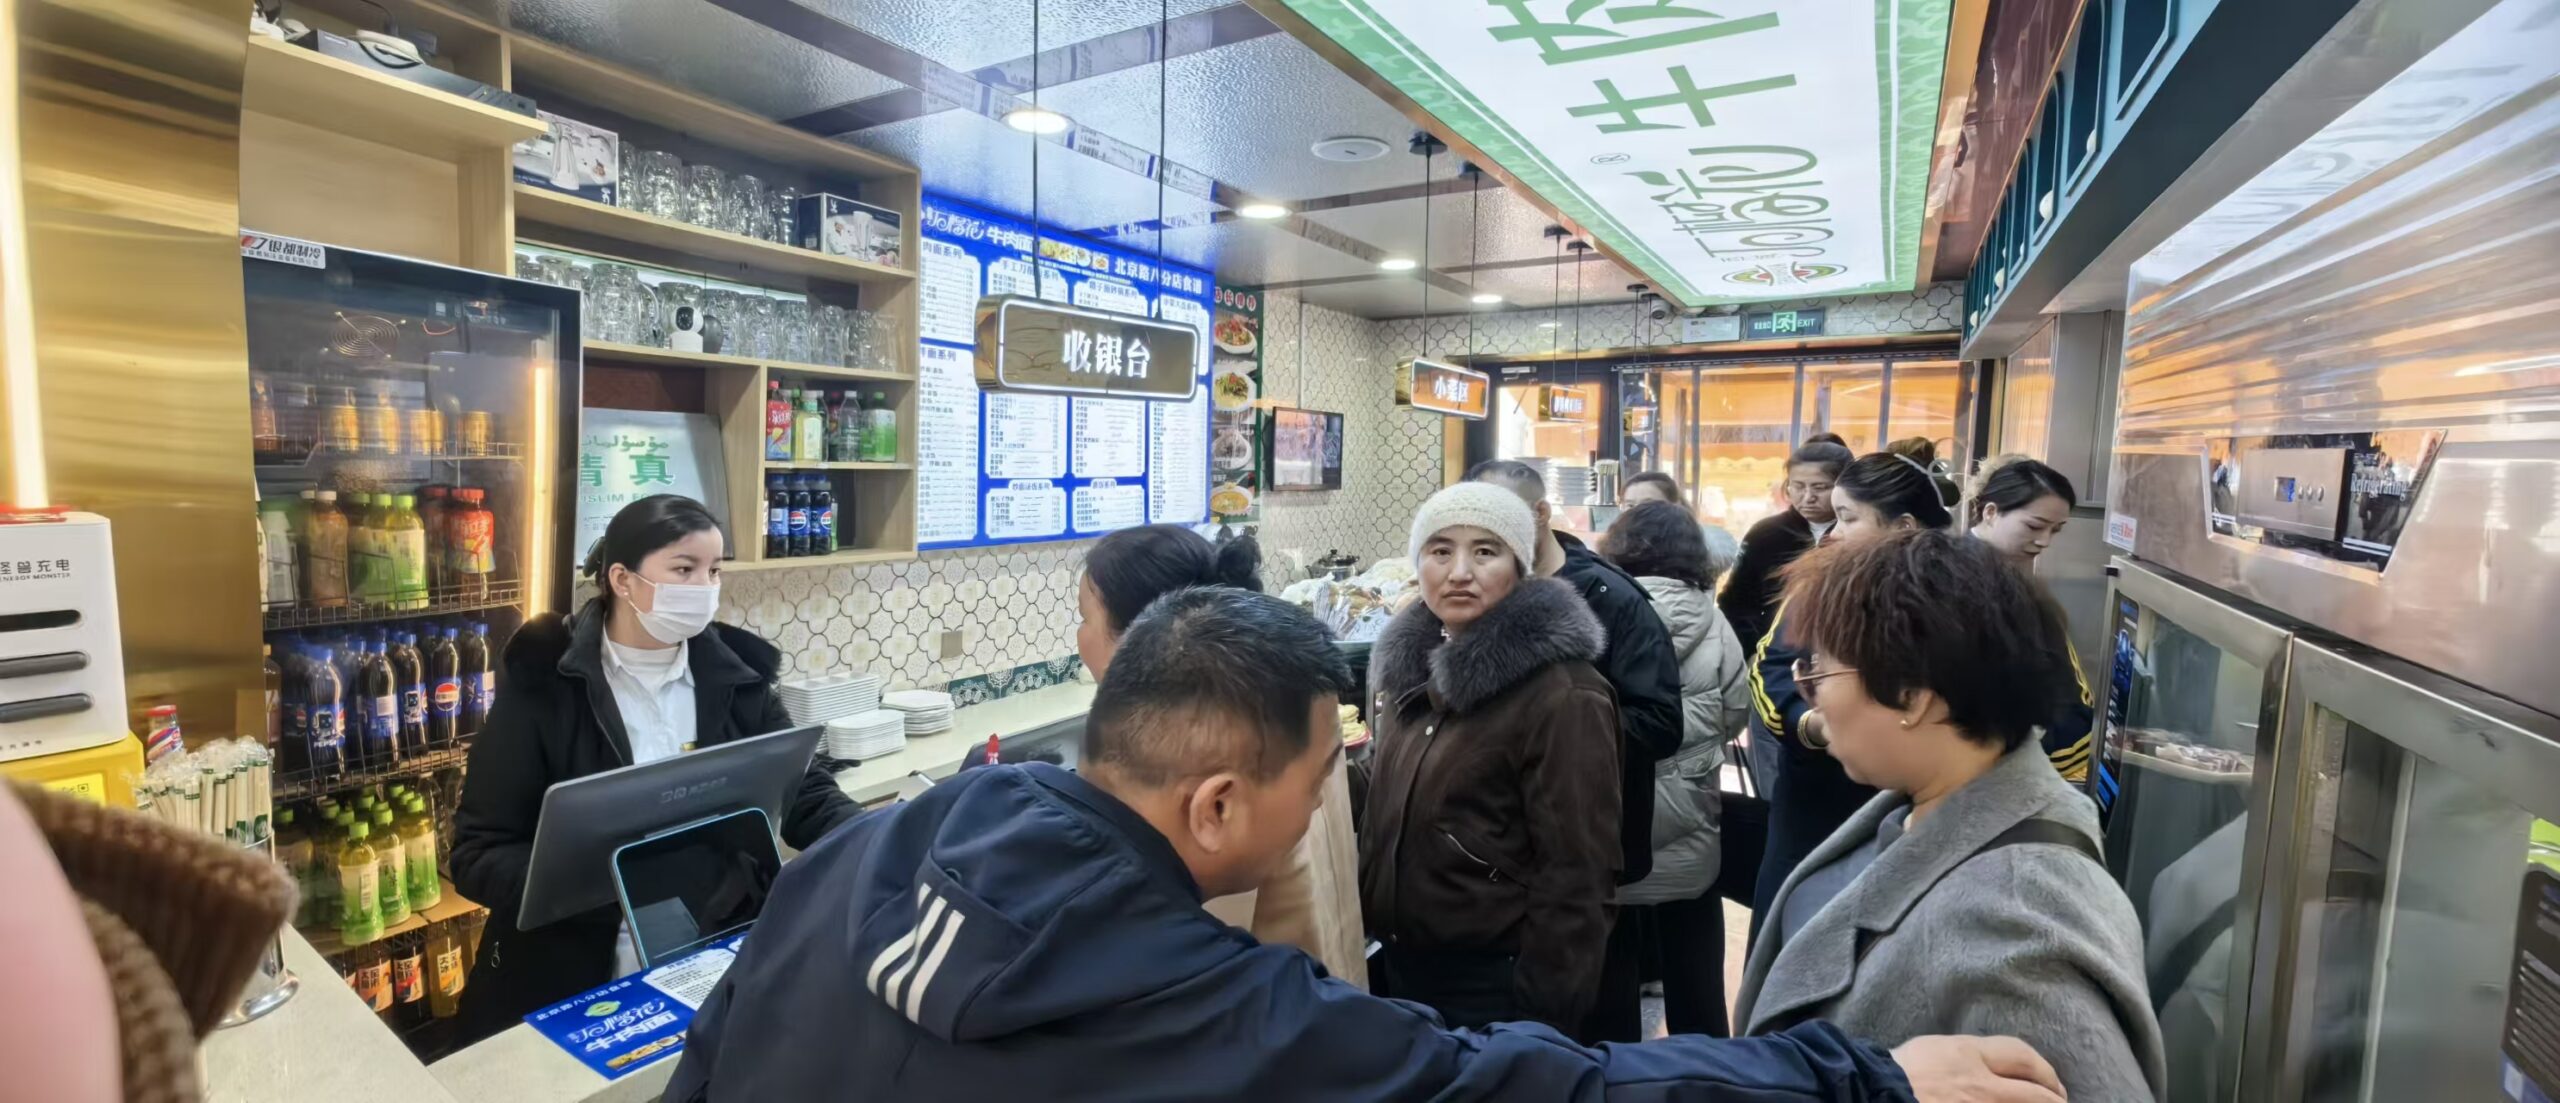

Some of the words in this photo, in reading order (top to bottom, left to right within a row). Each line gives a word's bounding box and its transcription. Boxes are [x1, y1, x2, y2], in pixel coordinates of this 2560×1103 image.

[1797, 318, 1816, 328] EXIT
[1062, 329, 1151, 379] 收银台
[585, 1010, 679, 1051] 牛肉面
